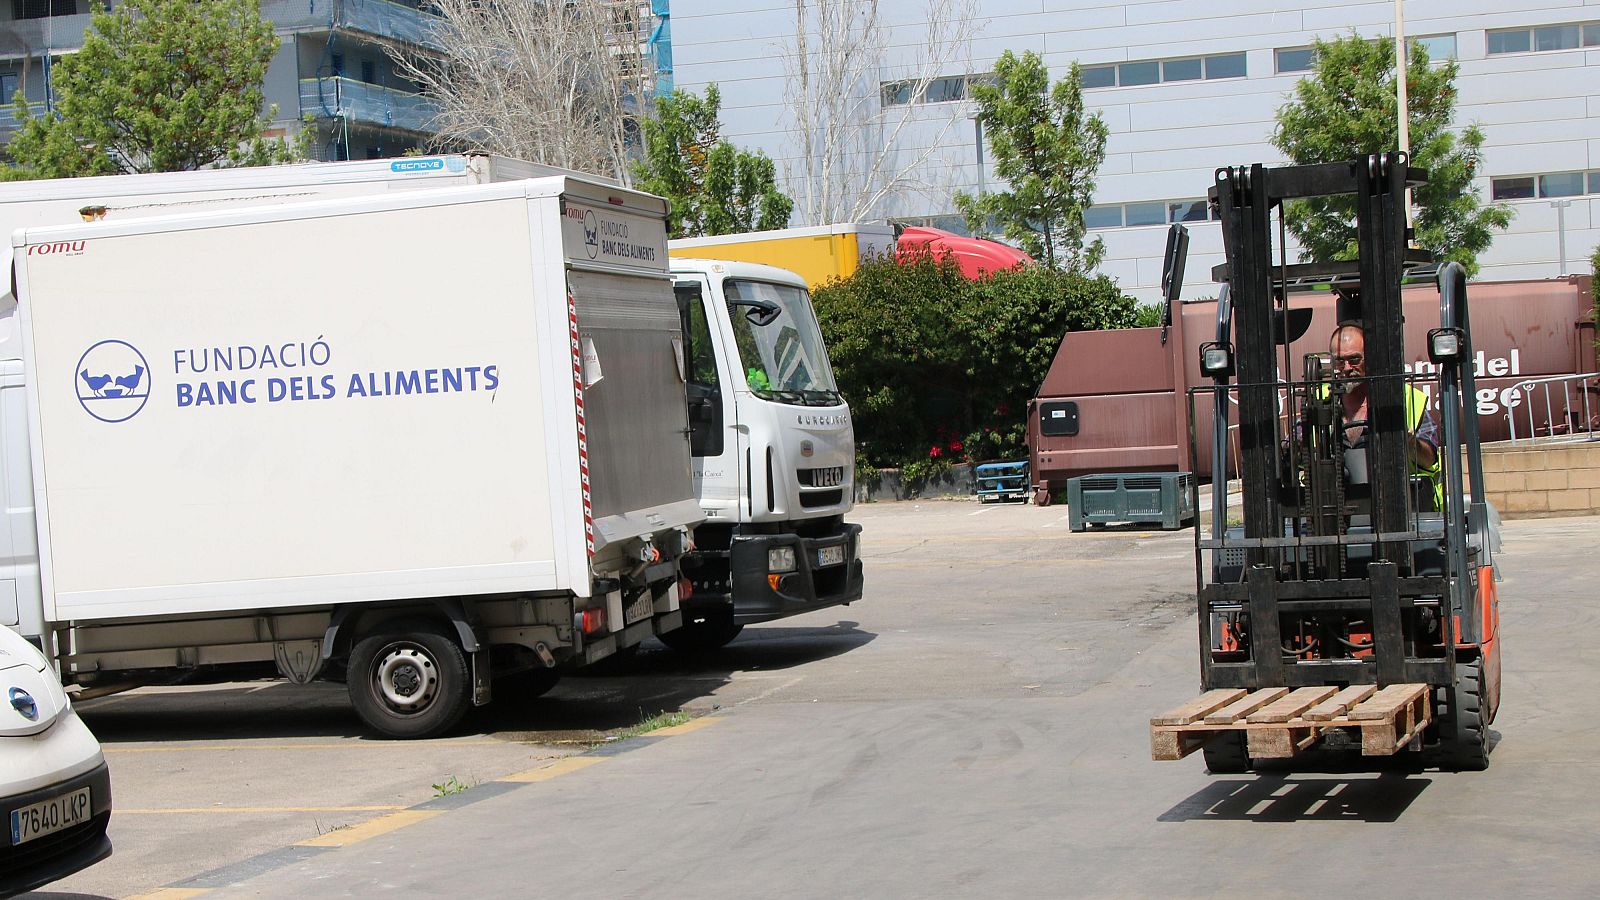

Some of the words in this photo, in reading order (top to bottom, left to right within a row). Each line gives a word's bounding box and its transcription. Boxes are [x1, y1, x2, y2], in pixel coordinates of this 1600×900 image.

[394, 161, 440, 170] TECNOVE
[600, 220, 629, 239] FUNDACIÓ
[28, 240, 86, 256] romu
[602, 240, 618, 256] BANC
[617, 242, 630, 258] DELS
[630, 244, 655, 262] ALIMENTS
[174, 334, 332, 374] FUNDACIÓ
[176, 379, 257, 407] BANC
[267, 375, 336, 402] DELS
[346, 364, 499, 398] ALIMENTS
[812, 467, 842, 487] IVECO
[21, 802, 58, 838] 7640
[62, 793, 87, 824] LKP
